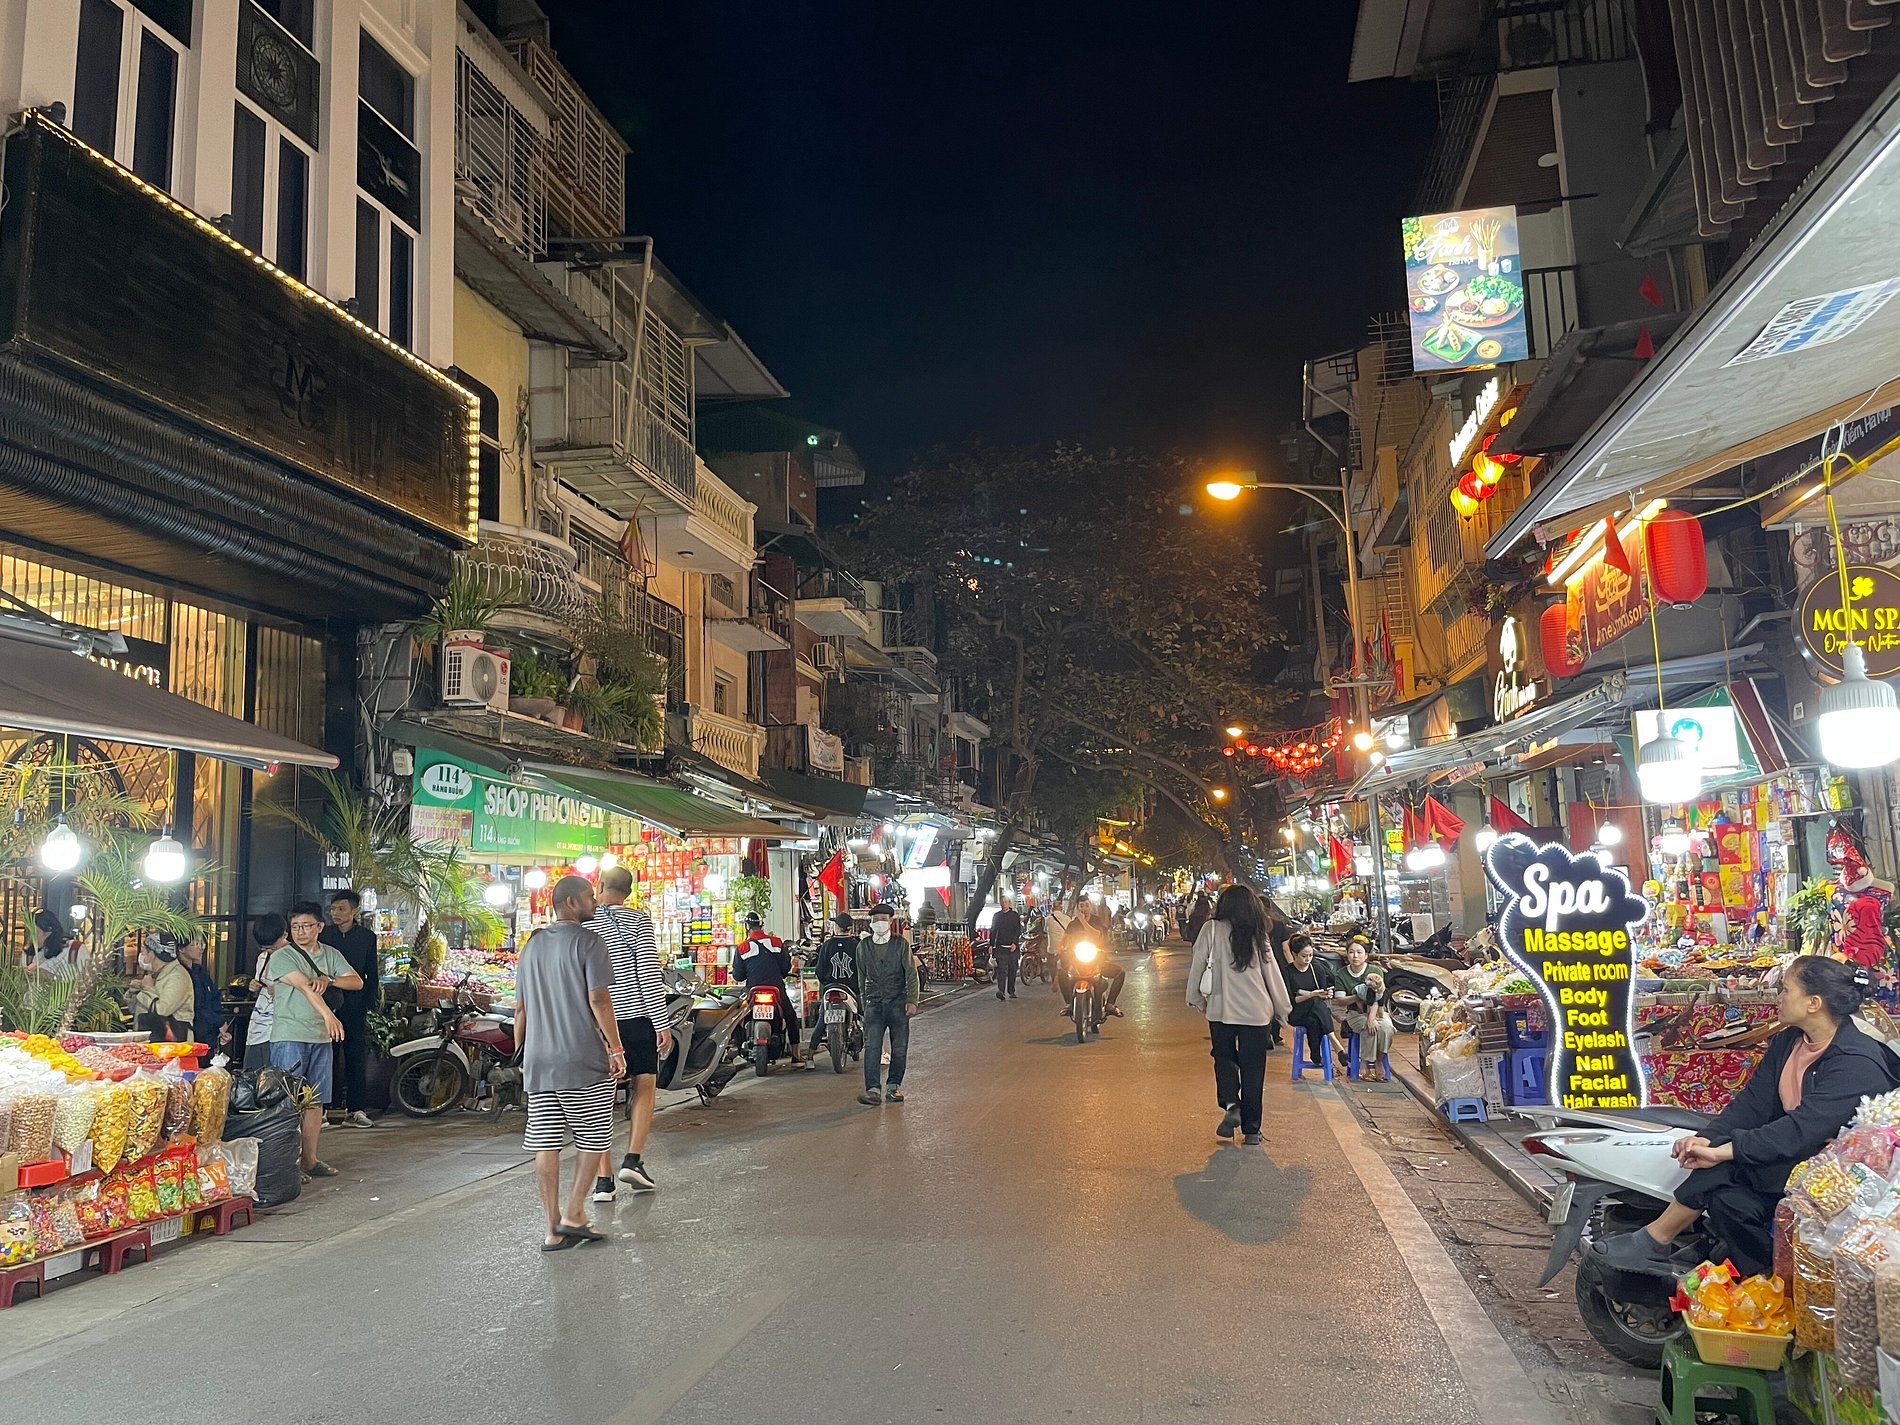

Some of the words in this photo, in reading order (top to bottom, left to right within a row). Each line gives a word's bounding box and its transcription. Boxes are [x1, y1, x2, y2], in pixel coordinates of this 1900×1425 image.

[1873, 607, 1900, 631] SP
[438, 765, 460, 784] 114
[484, 784, 528, 818] SHOP
[479, 823, 494, 844] 114
[1519, 862, 1610, 932] Spa
[1523, 927, 1628, 957] Massage
[830, 951, 854, 980] NY
[1542, 960, 1591, 982] Private
[1593, 963, 1629, 981] room
[1559, 986, 1608, 1008] Body
[1566, 1009, 1609, 1026] Foot
[1564, 1030, 1626, 1052] Eyelash
[1575, 1054, 1615, 1072] Nail
[1569, 1074, 1628, 1091] Facial
[1562, 1093, 1595, 1110] Hair
[1598, 1092, 1639, 1108] wash
